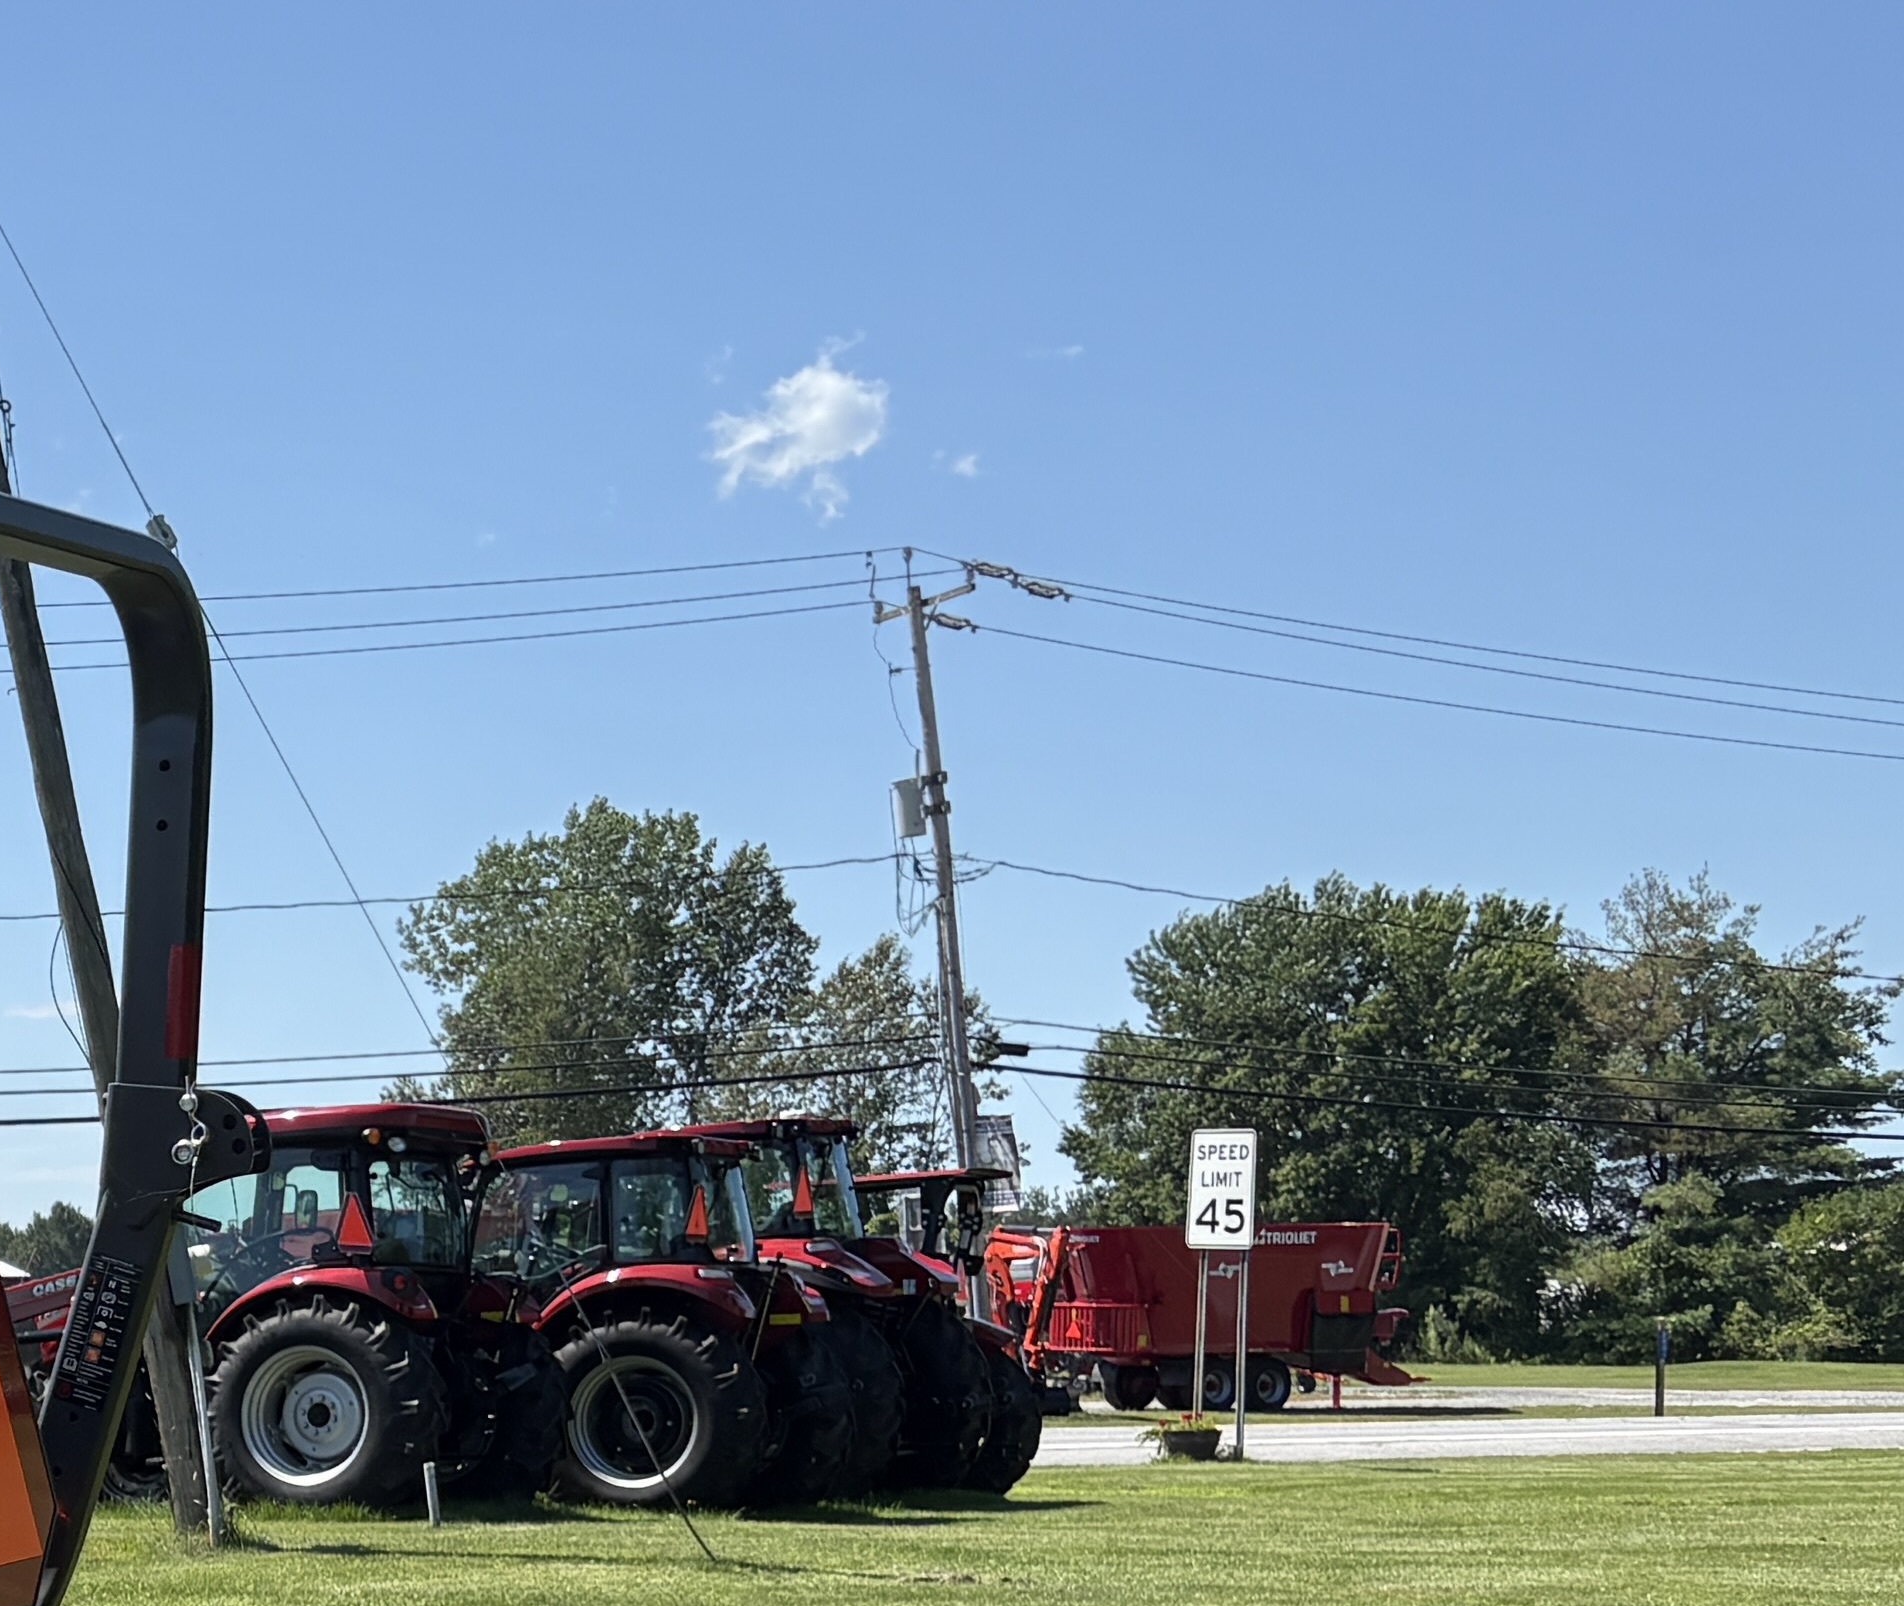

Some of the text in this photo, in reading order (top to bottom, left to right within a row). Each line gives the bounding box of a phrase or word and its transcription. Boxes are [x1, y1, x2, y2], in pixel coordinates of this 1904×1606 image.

[1197, 1144, 1250, 1161] SPEED
[1201, 1171, 1242, 1188] LIMIT
[1195, 1198, 1245, 1234] 45
